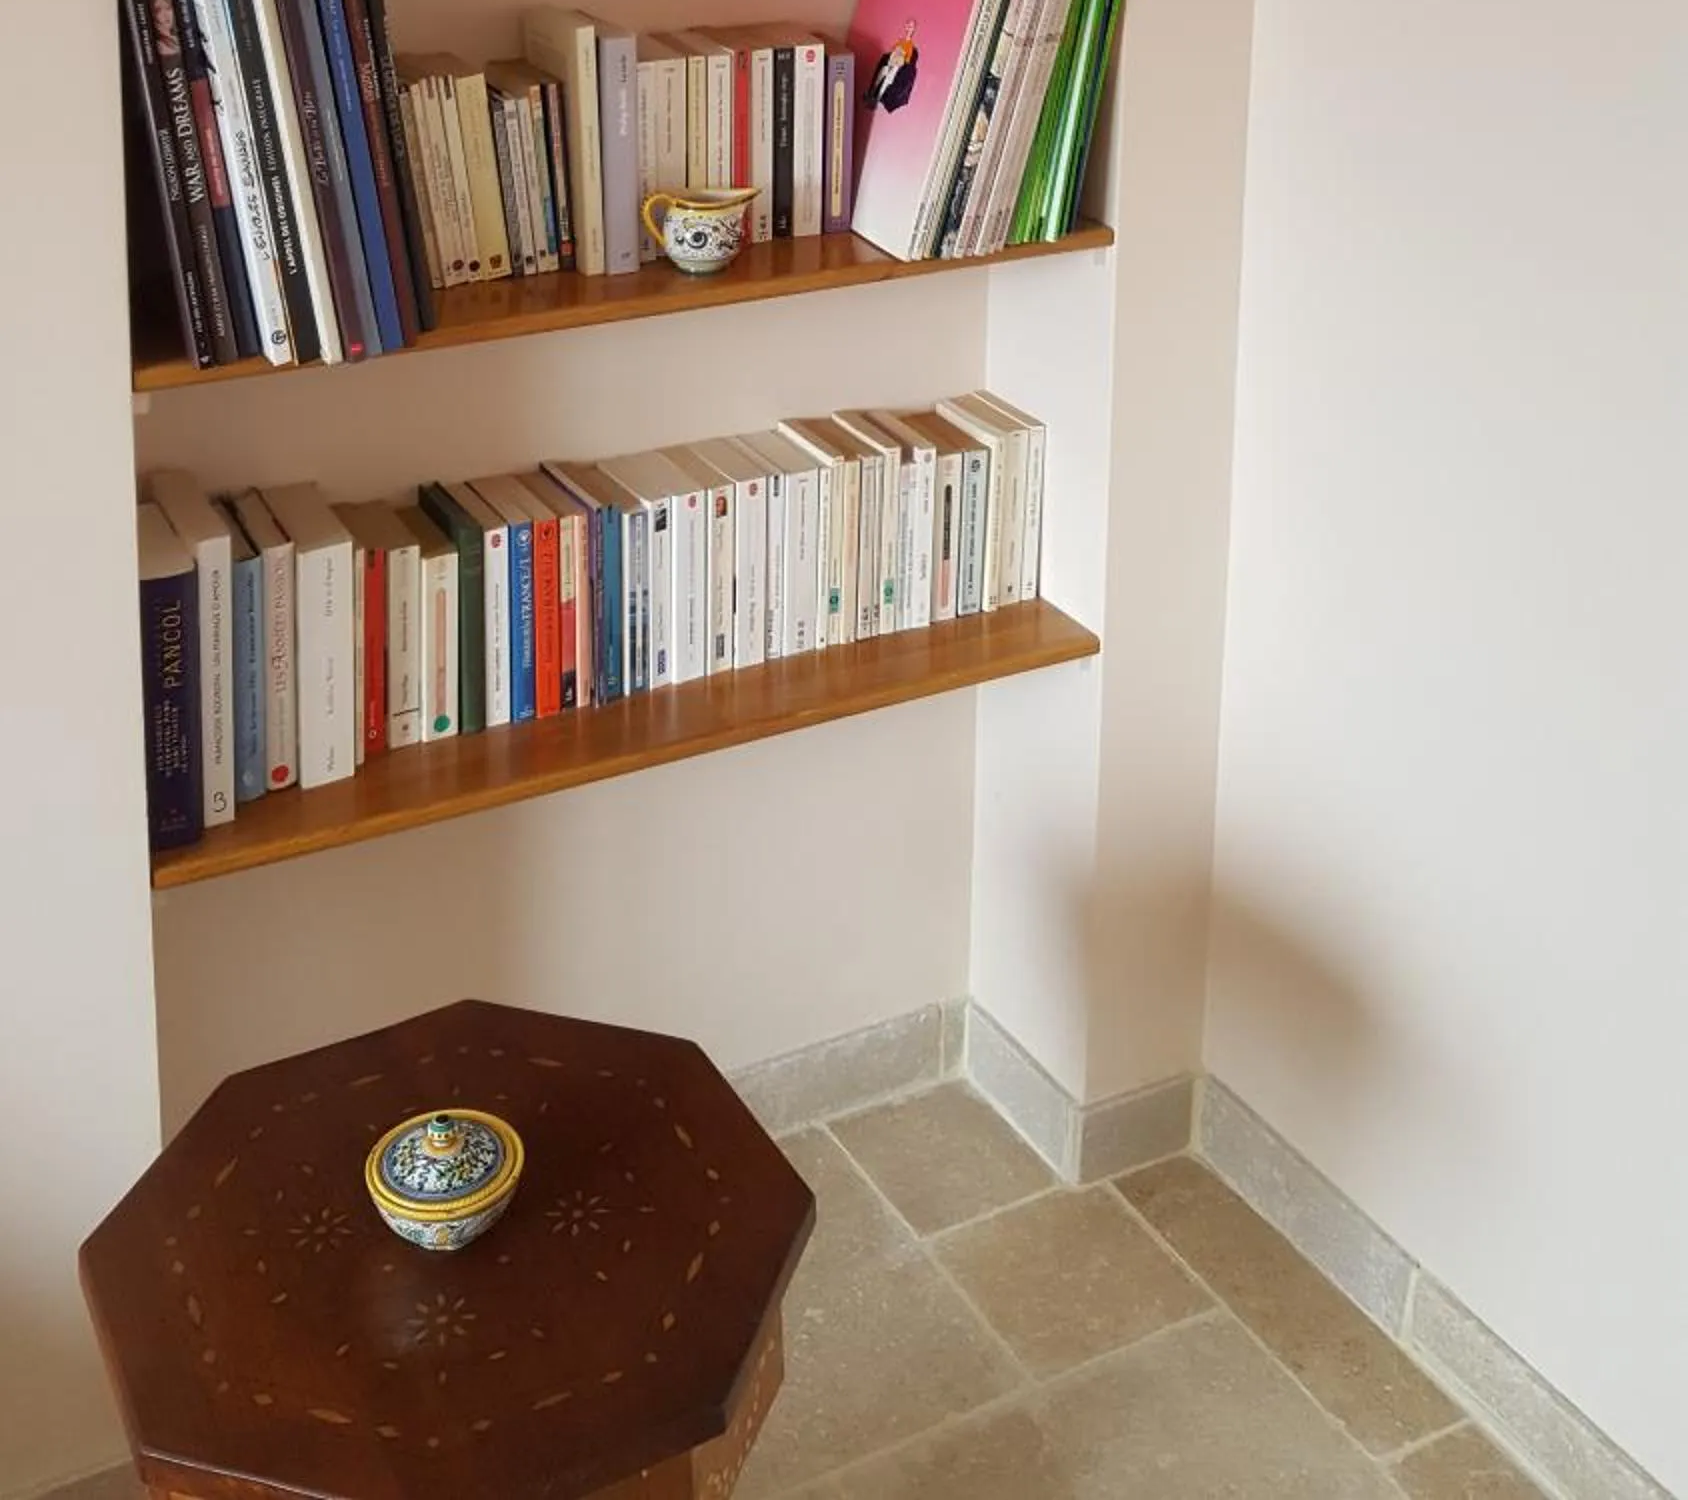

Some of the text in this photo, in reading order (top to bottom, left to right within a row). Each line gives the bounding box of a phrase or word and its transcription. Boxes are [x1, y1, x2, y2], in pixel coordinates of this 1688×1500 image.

[166, 67, 193, 139] DREAMS
[183, 140, 197, 161] AND
[185, 163, 205, 204] WAR
[163, 599, 183, 689] PANCOL
